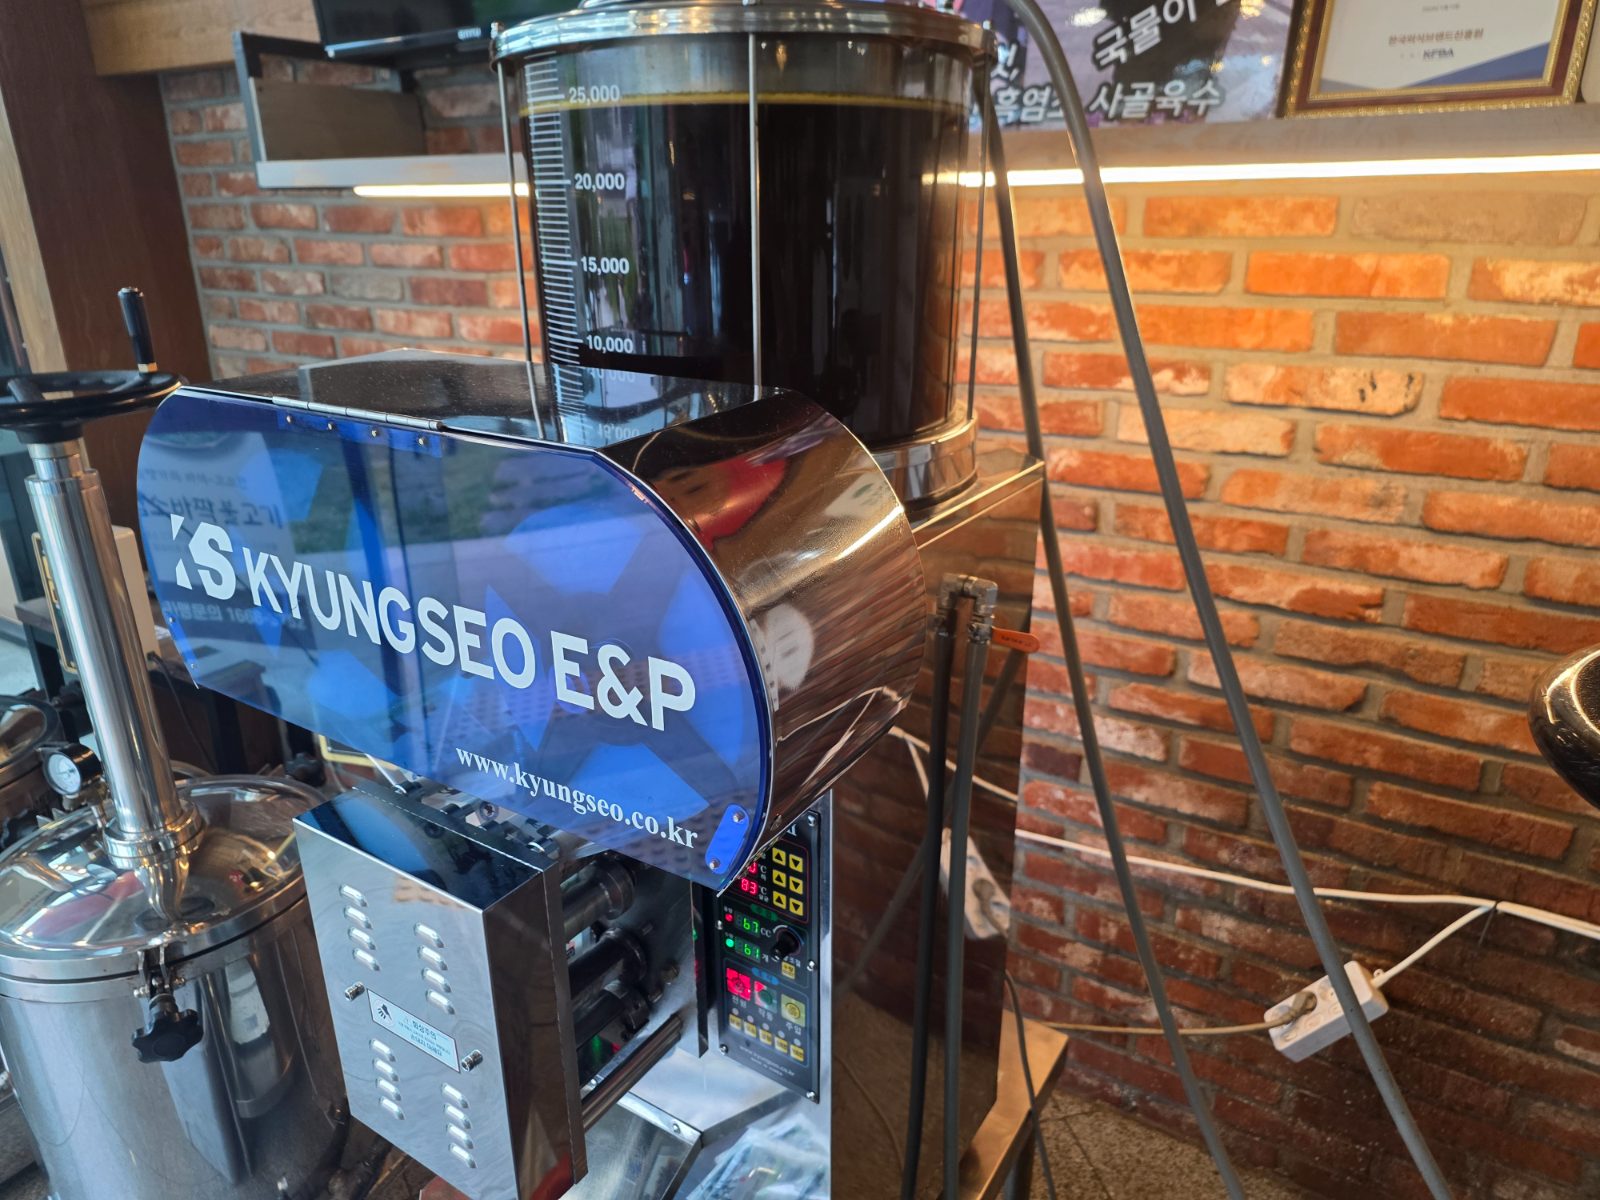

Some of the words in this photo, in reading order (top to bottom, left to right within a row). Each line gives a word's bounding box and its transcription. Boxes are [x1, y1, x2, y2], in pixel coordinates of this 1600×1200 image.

[1095, 0, 1198, 67] 국물이
[568, 85, 620, 104] 25,000
[1089, 79, 1222, 118] 사골육수
[574, 172, 625, 192] 20,000
[581, 256, 630, 275] 15,000
[586, 335, 633, 354] 10,000
[242, 547, 536, 689] KYUNGSEO
[550, 630, 696, 732] E&P
[456, 747, 698, 849] www.kyungseo.co.kr
